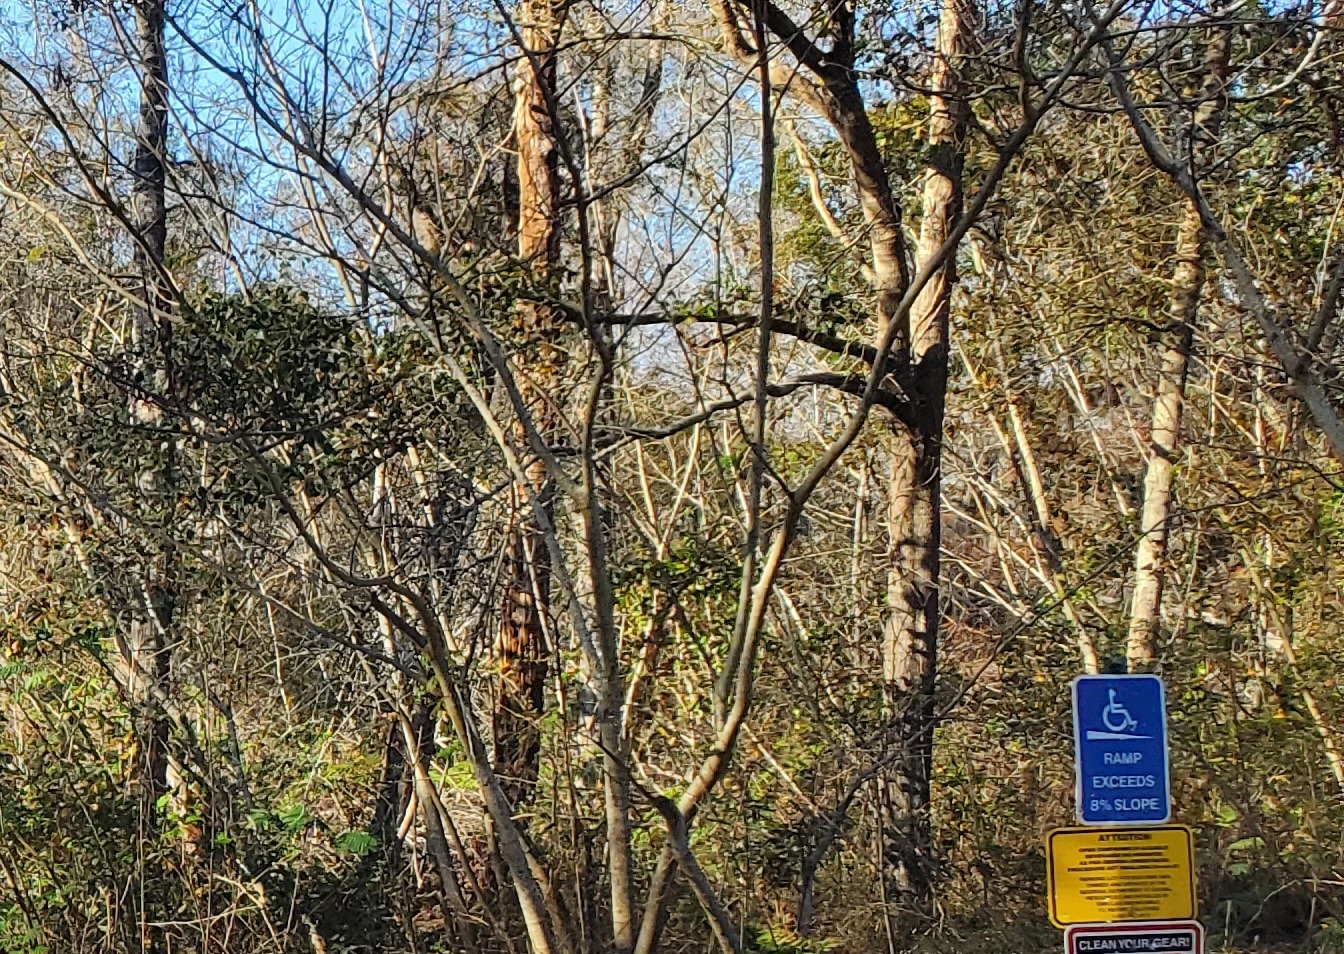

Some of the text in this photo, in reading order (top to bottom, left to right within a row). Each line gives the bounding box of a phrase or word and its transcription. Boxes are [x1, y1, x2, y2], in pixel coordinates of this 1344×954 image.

[1104, 753, 1143, 765] RAMP
[1092, 775, 1155, 788] EXCEEDS
[1090, 798, 1160, 812] 8% SLOPE
[1079, 937, 1190, 951] CLEAN YOUR GEAR!
